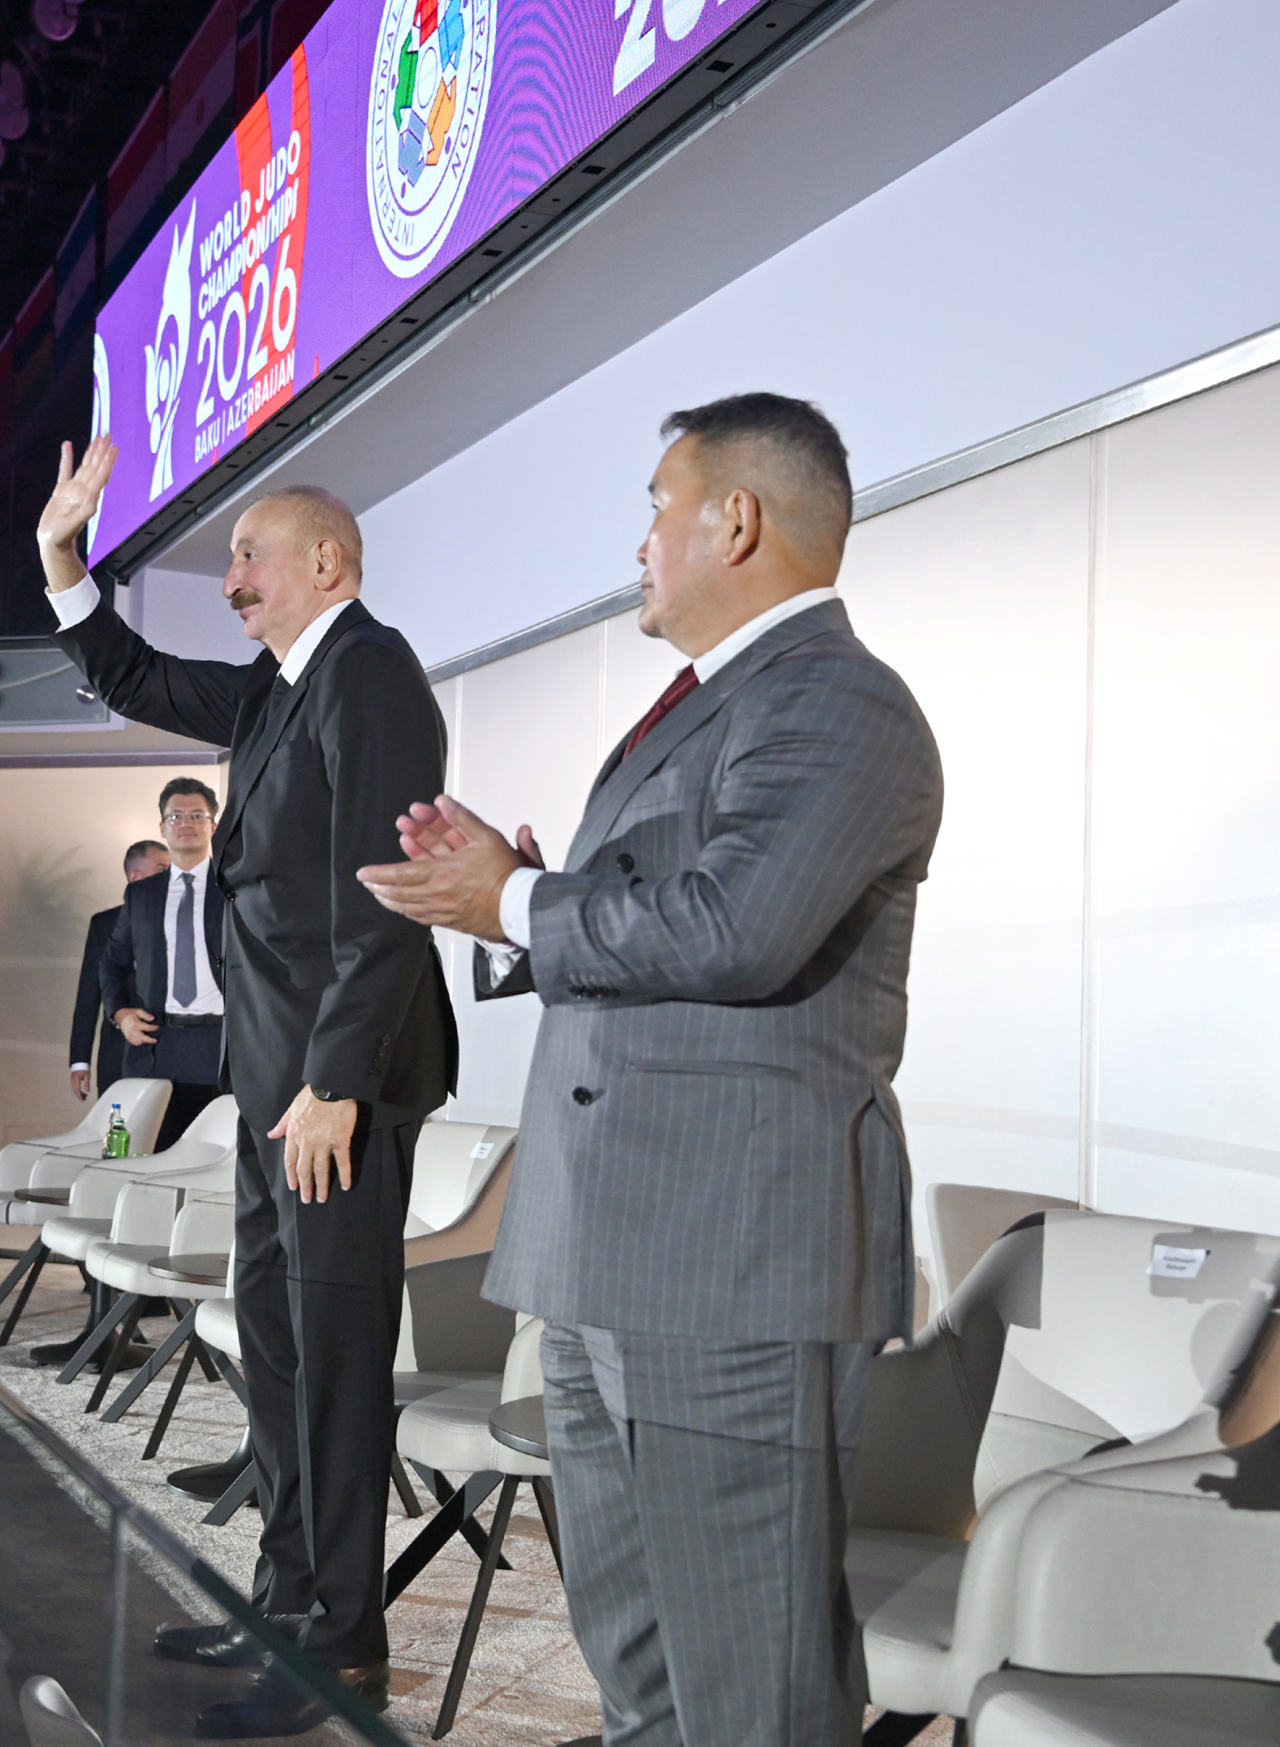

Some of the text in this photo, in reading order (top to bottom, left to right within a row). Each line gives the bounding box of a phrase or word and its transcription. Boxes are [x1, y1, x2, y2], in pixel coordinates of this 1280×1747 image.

[198, 176, 299, 320] CHAMPIONSHIPS
[199, 129, 301, 278] WORLD JUDO
[195, 233, 298, 428] 2026
[194, 348, 295, 464] BAKU AZERBAIJAN
